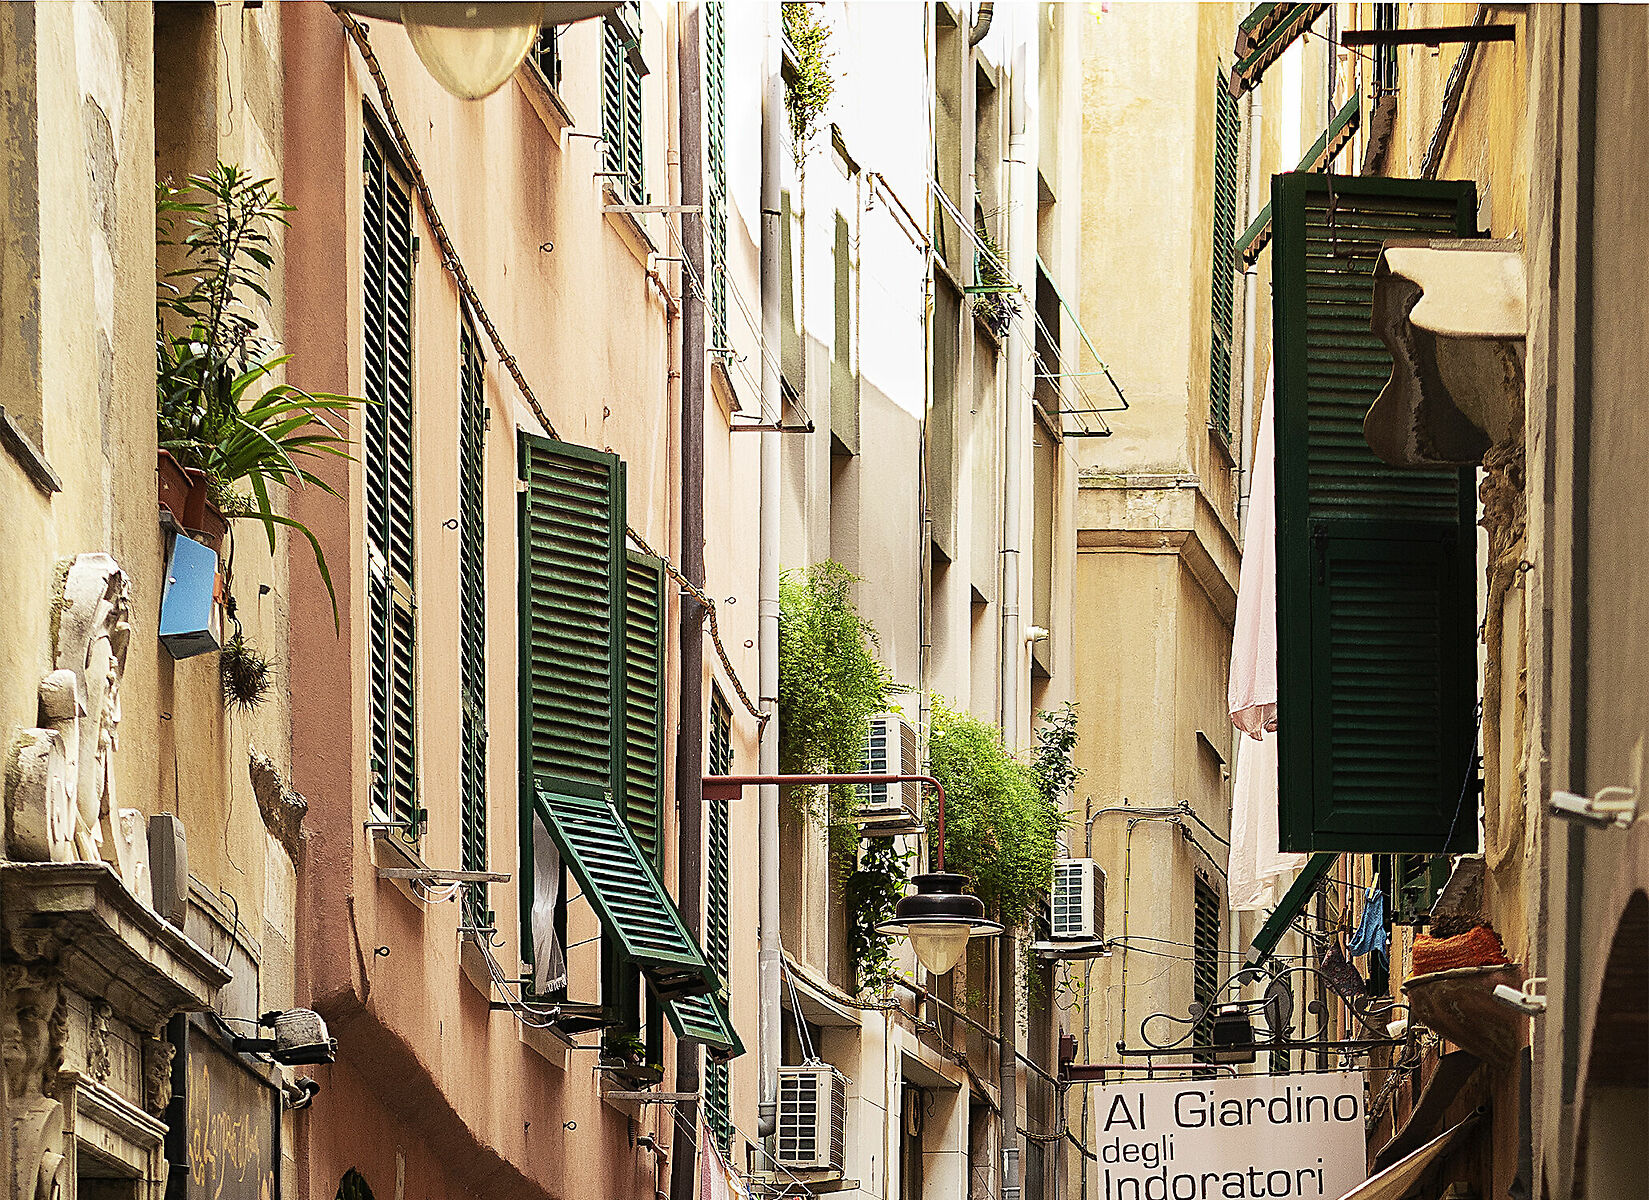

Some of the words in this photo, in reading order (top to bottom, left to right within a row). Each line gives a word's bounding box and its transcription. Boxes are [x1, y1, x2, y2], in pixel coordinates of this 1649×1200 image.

[1103, 1092, 1146, 1132] Al
[1173, 1086, 1359, 1128] Giardino
[1102, 1133, 1175, 1169] degli
